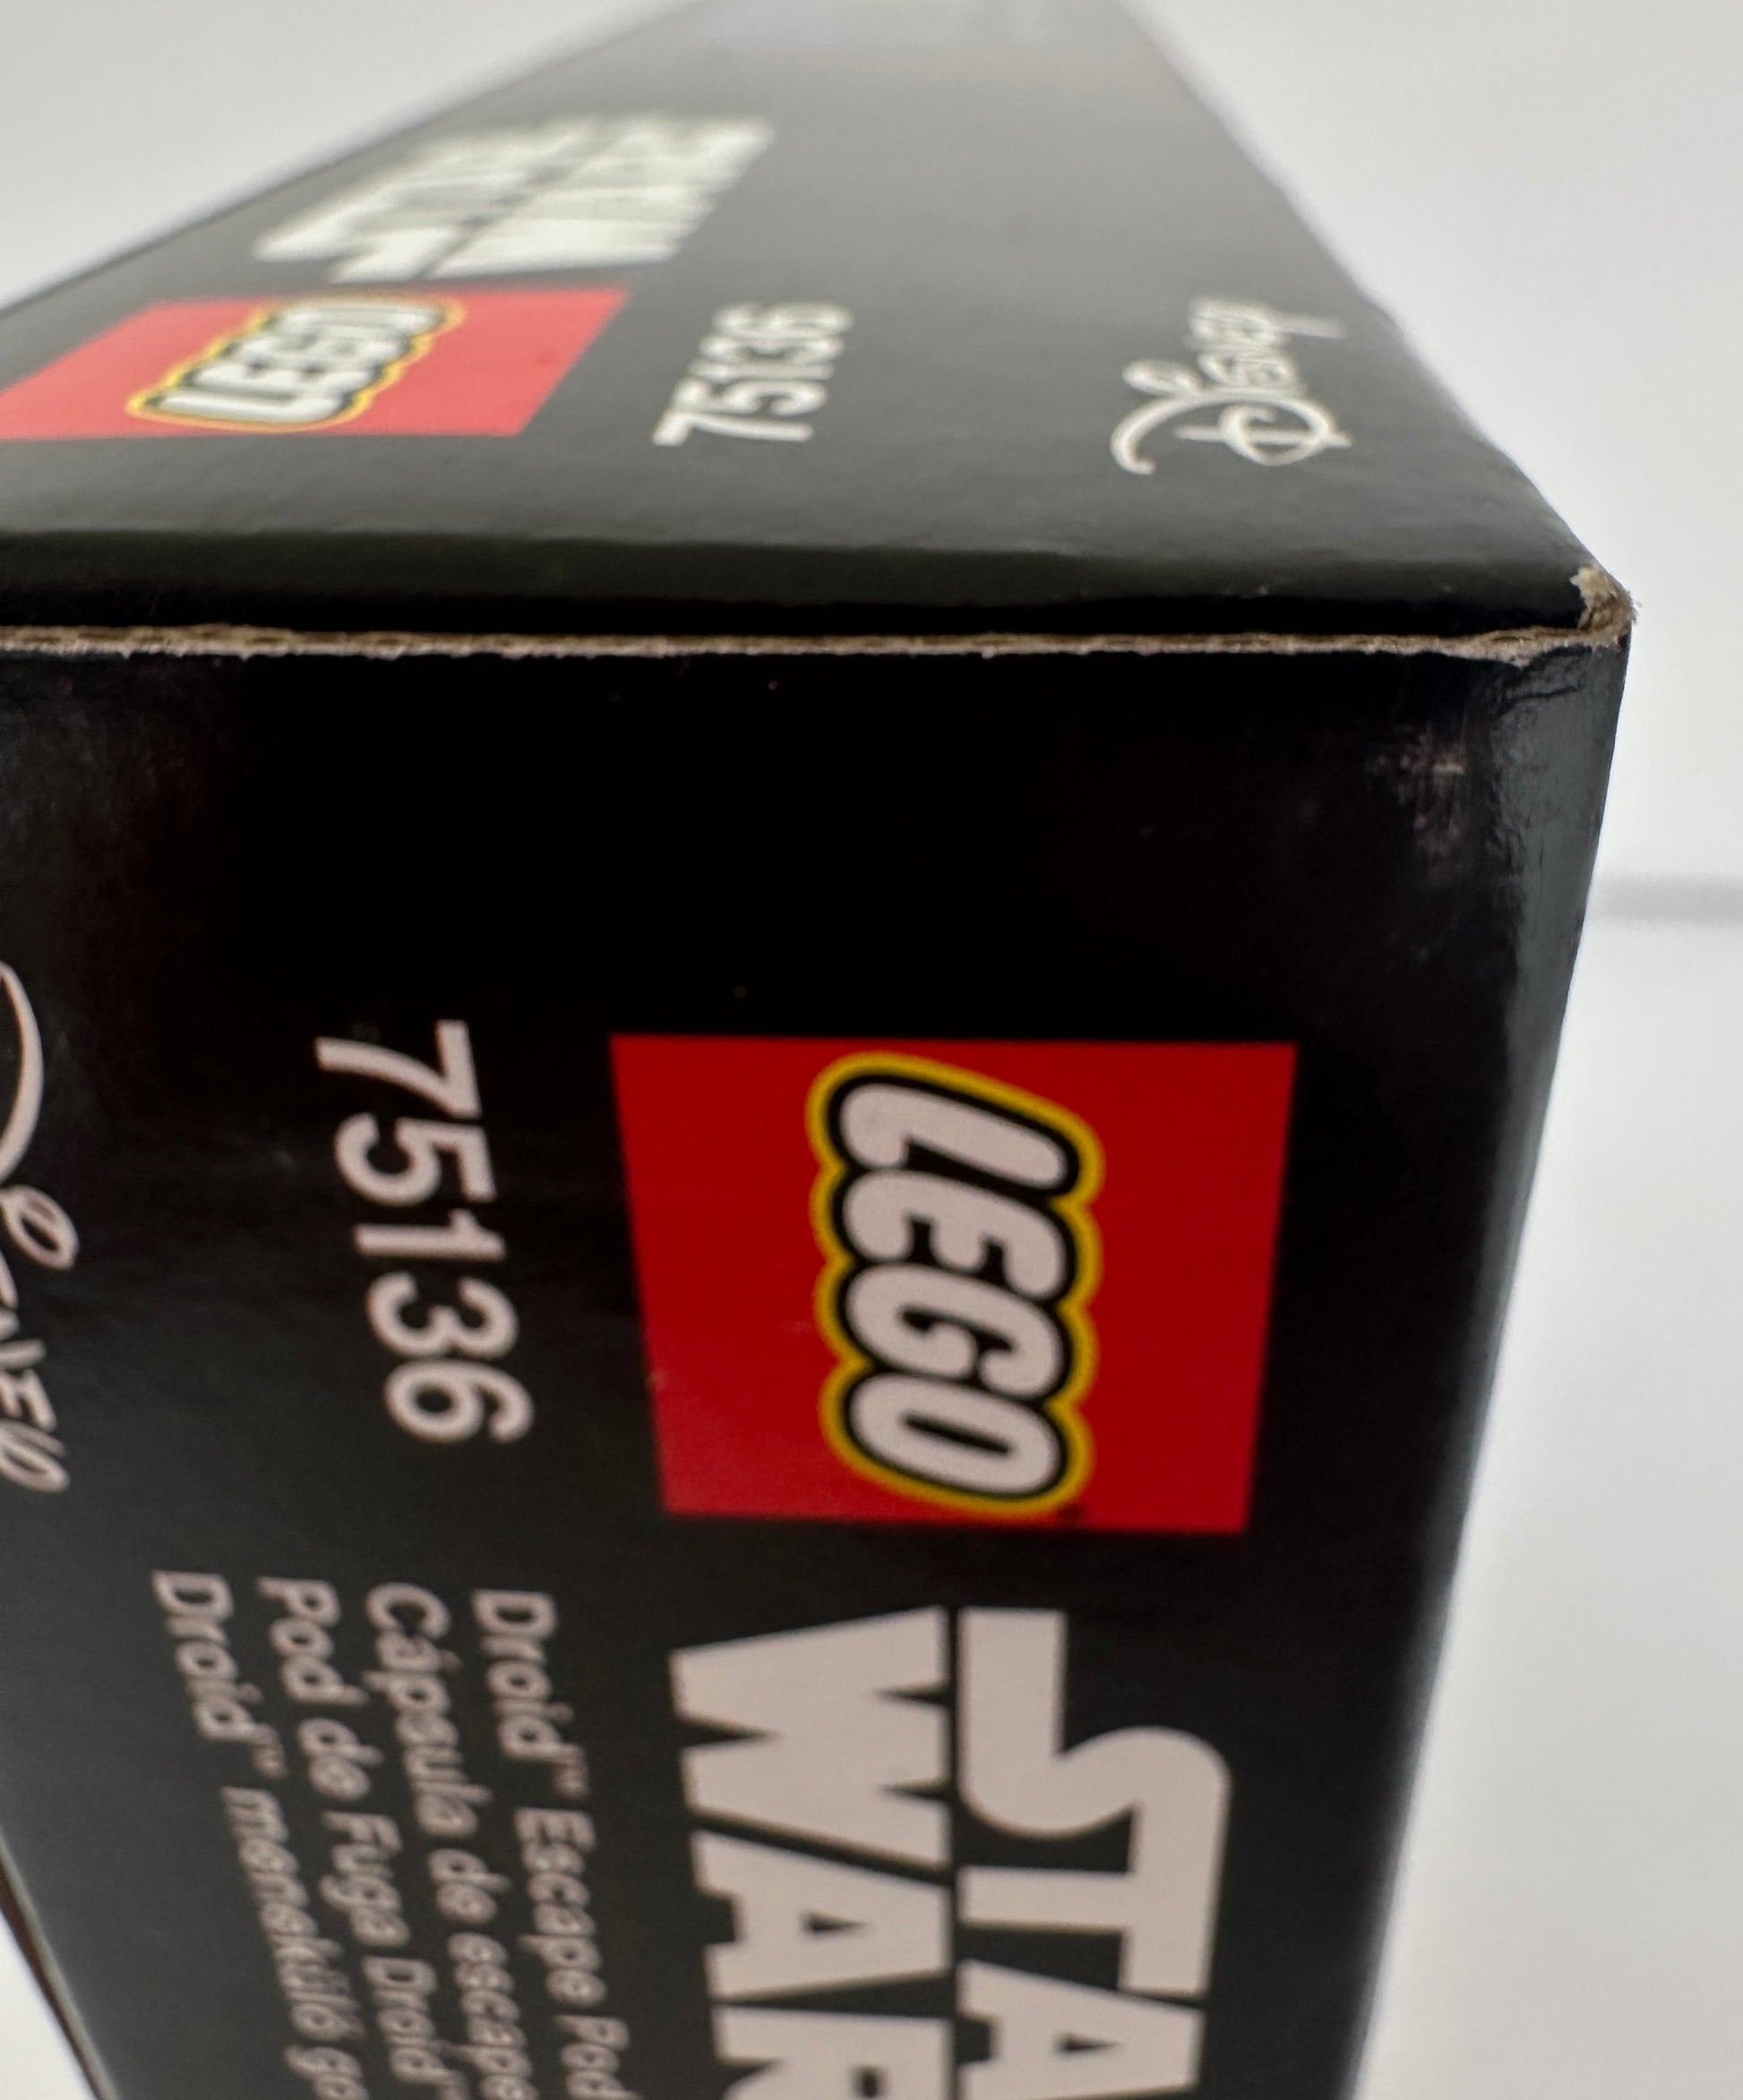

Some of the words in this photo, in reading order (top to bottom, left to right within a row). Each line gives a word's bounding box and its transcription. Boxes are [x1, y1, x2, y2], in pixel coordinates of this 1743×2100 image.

[125, 294, 468, 433] LEGO
[652, 300, 854, 448] 75136
[315, 1020, 536, 1445] 75136
[805, 1051, 1105, 1519] LEGO
[256, 1575, 370, 1705] Pod
[362, 1581, 494, 1840] Cápsula
[295, 1717, 385, 1800] de
[318, 1811, 410, 1949] Fuga
[426, 1847, 511, 1925] de
[513, 1806, 607, 2007] Escape
[446, 1931, 537, 2100] escape
[554, 2014, 641, 2100] Pod
